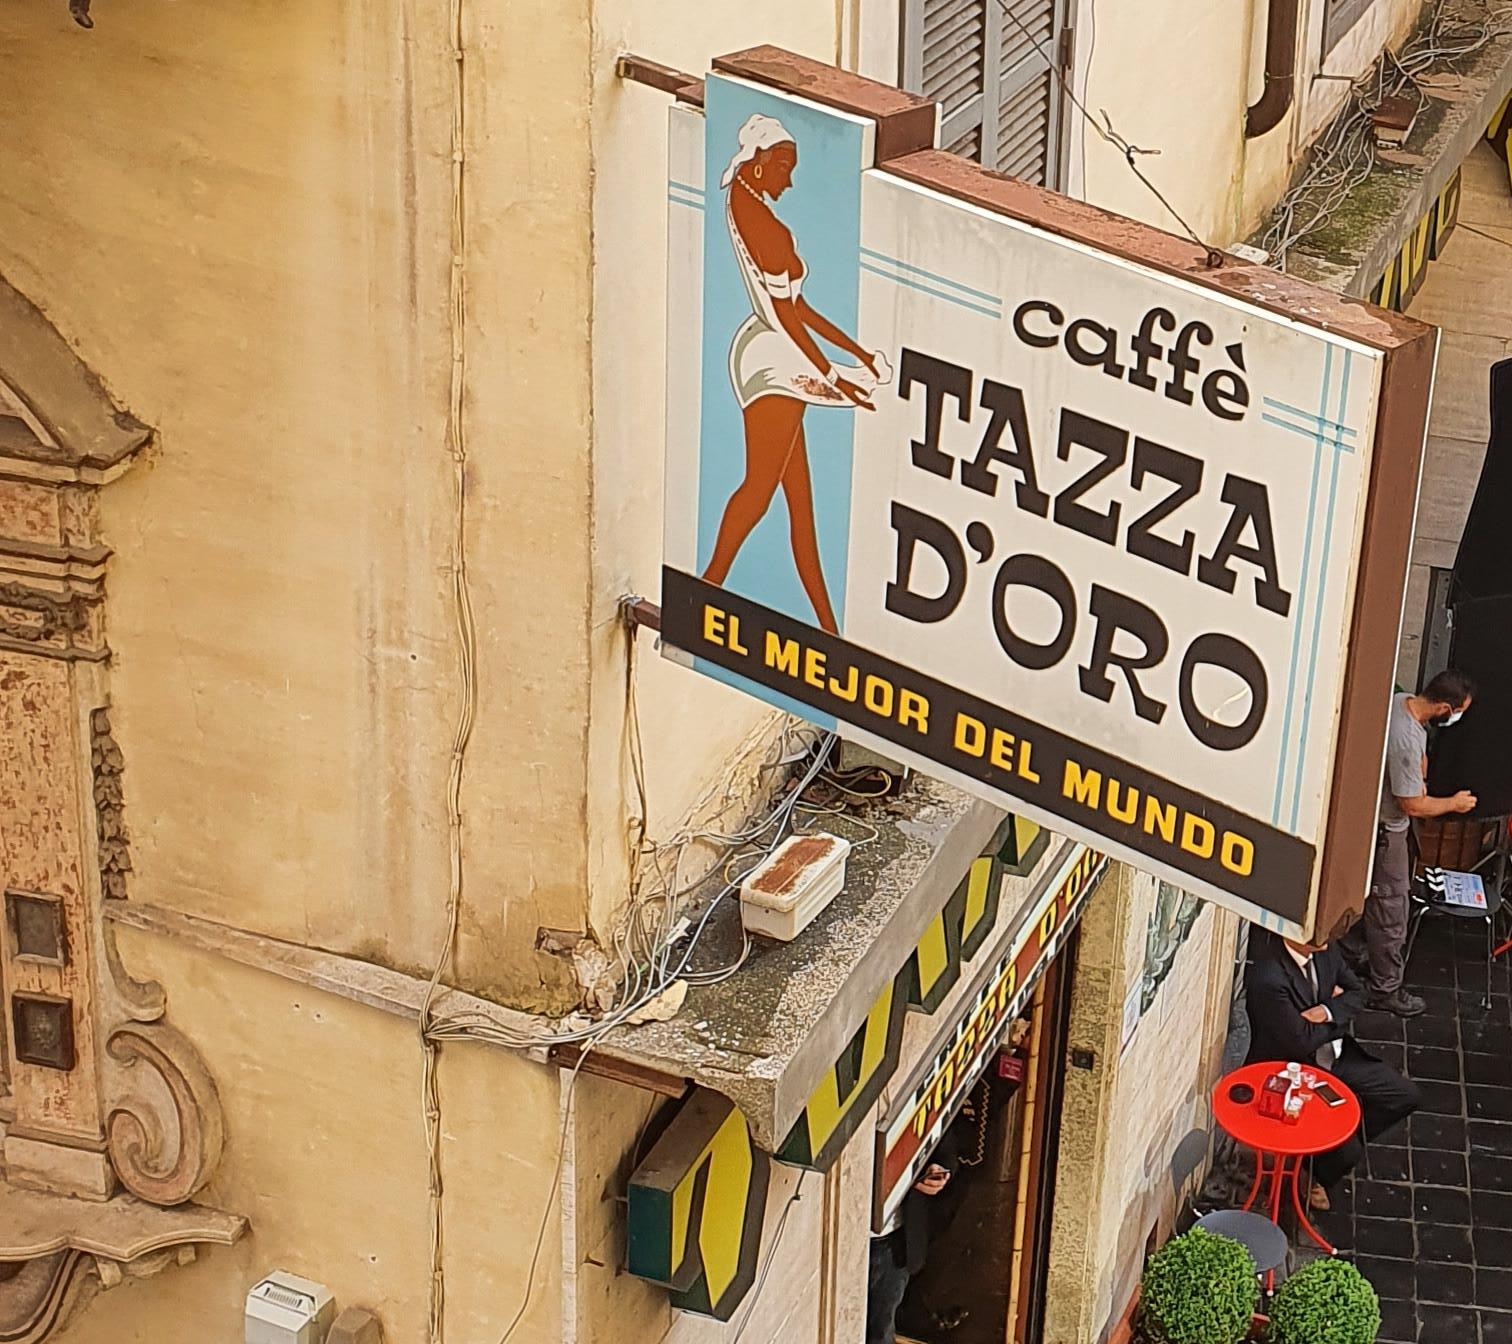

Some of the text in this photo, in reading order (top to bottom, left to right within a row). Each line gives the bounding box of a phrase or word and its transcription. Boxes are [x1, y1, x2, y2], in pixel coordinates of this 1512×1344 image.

[898, 346, 1293, 618] TAZZA
[1011, 297, 1251, 422] caffè
[703, 603, 1255, 877] EL MEJOR DEL MUNDO
[883, 499, 1269, 752] D'ORO
